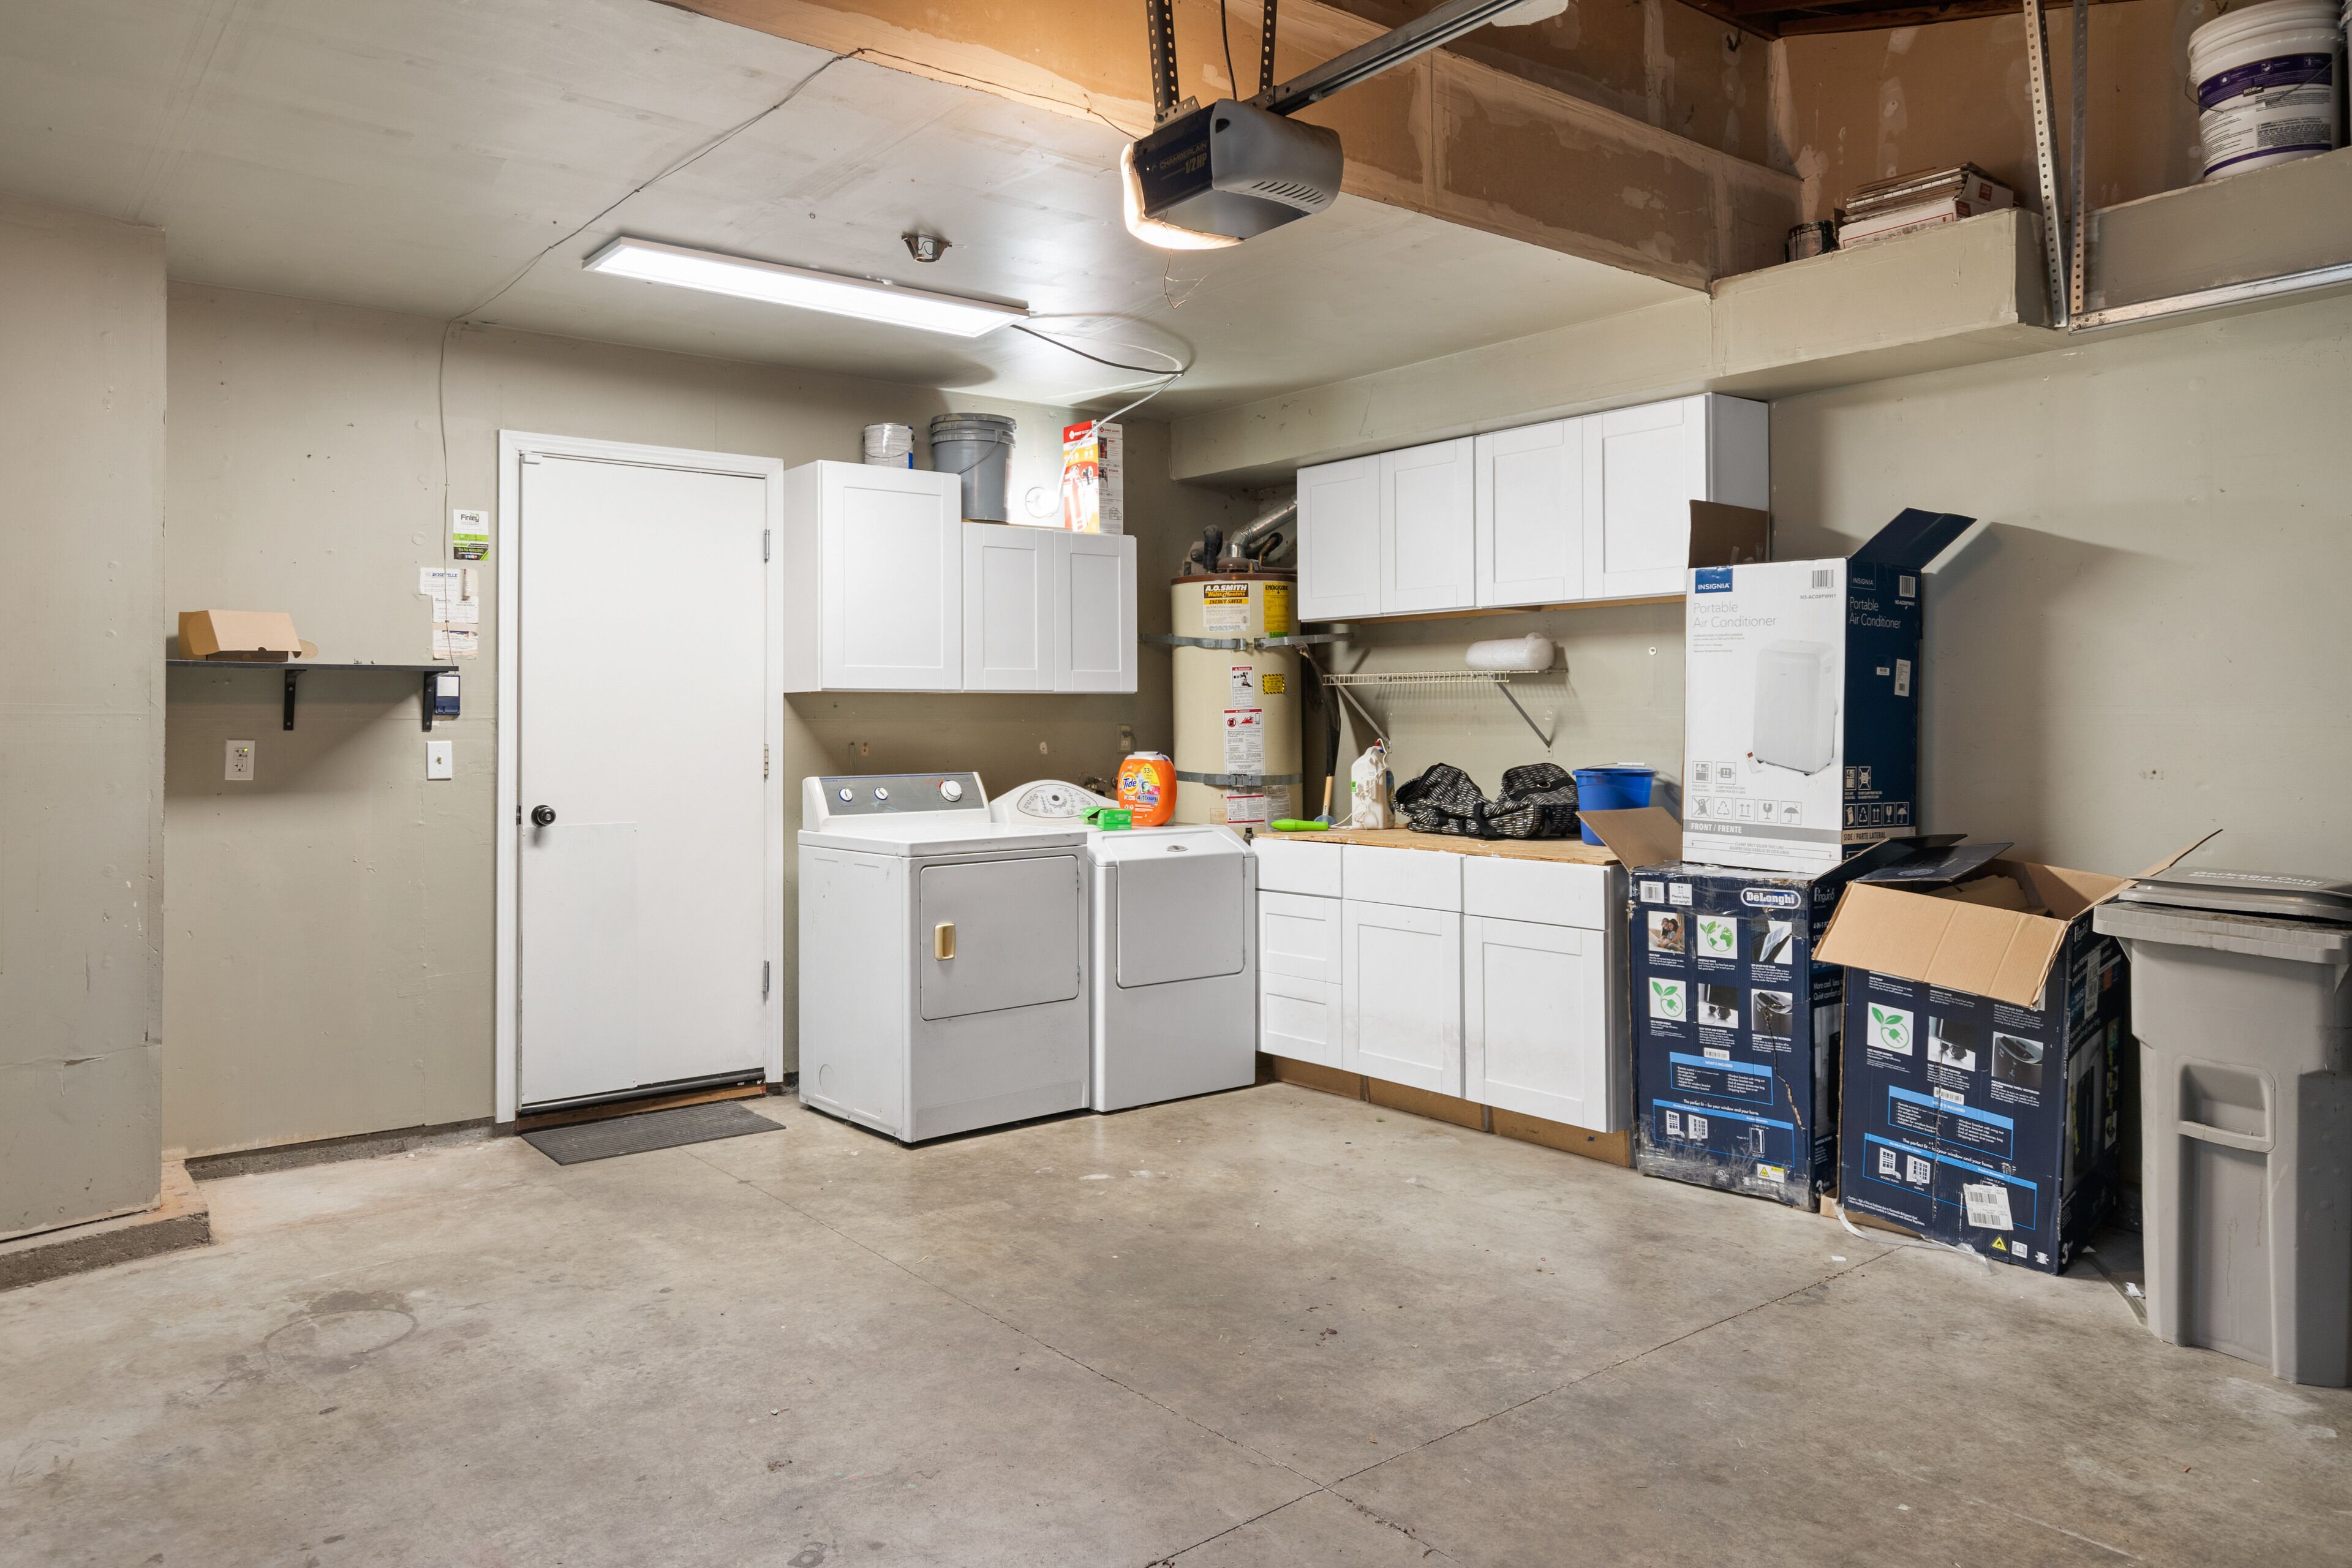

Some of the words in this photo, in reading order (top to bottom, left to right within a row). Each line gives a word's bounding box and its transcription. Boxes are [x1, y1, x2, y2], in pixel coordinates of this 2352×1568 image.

[1159, 141, 1206, 168] CHAMBERLAIN
[461, 514, 480, 522] Finley
[1694, 601, 1738, 614] Portable
[1850, 596, 1879, 611] Portable
[1693, 617, 1708, 628] Air
[1711, 616, 1777, 628] Conditioner
[1849, 612, 1860, 625] Air
[1861, 613, 1901, 628] Conditioner
[1123, 778, 1137, 790] Tide
[1691, 823, 1713, 831] FRONT
[1717, 825, 1742, 834] FRENTE
[2238, 877, 2318, 886] Solamente
[1814, 992, 1824, 1001] Quiet
[1824, 990, 1838, 998] comfort
[2062, 1243, 2068, 1265] 3
